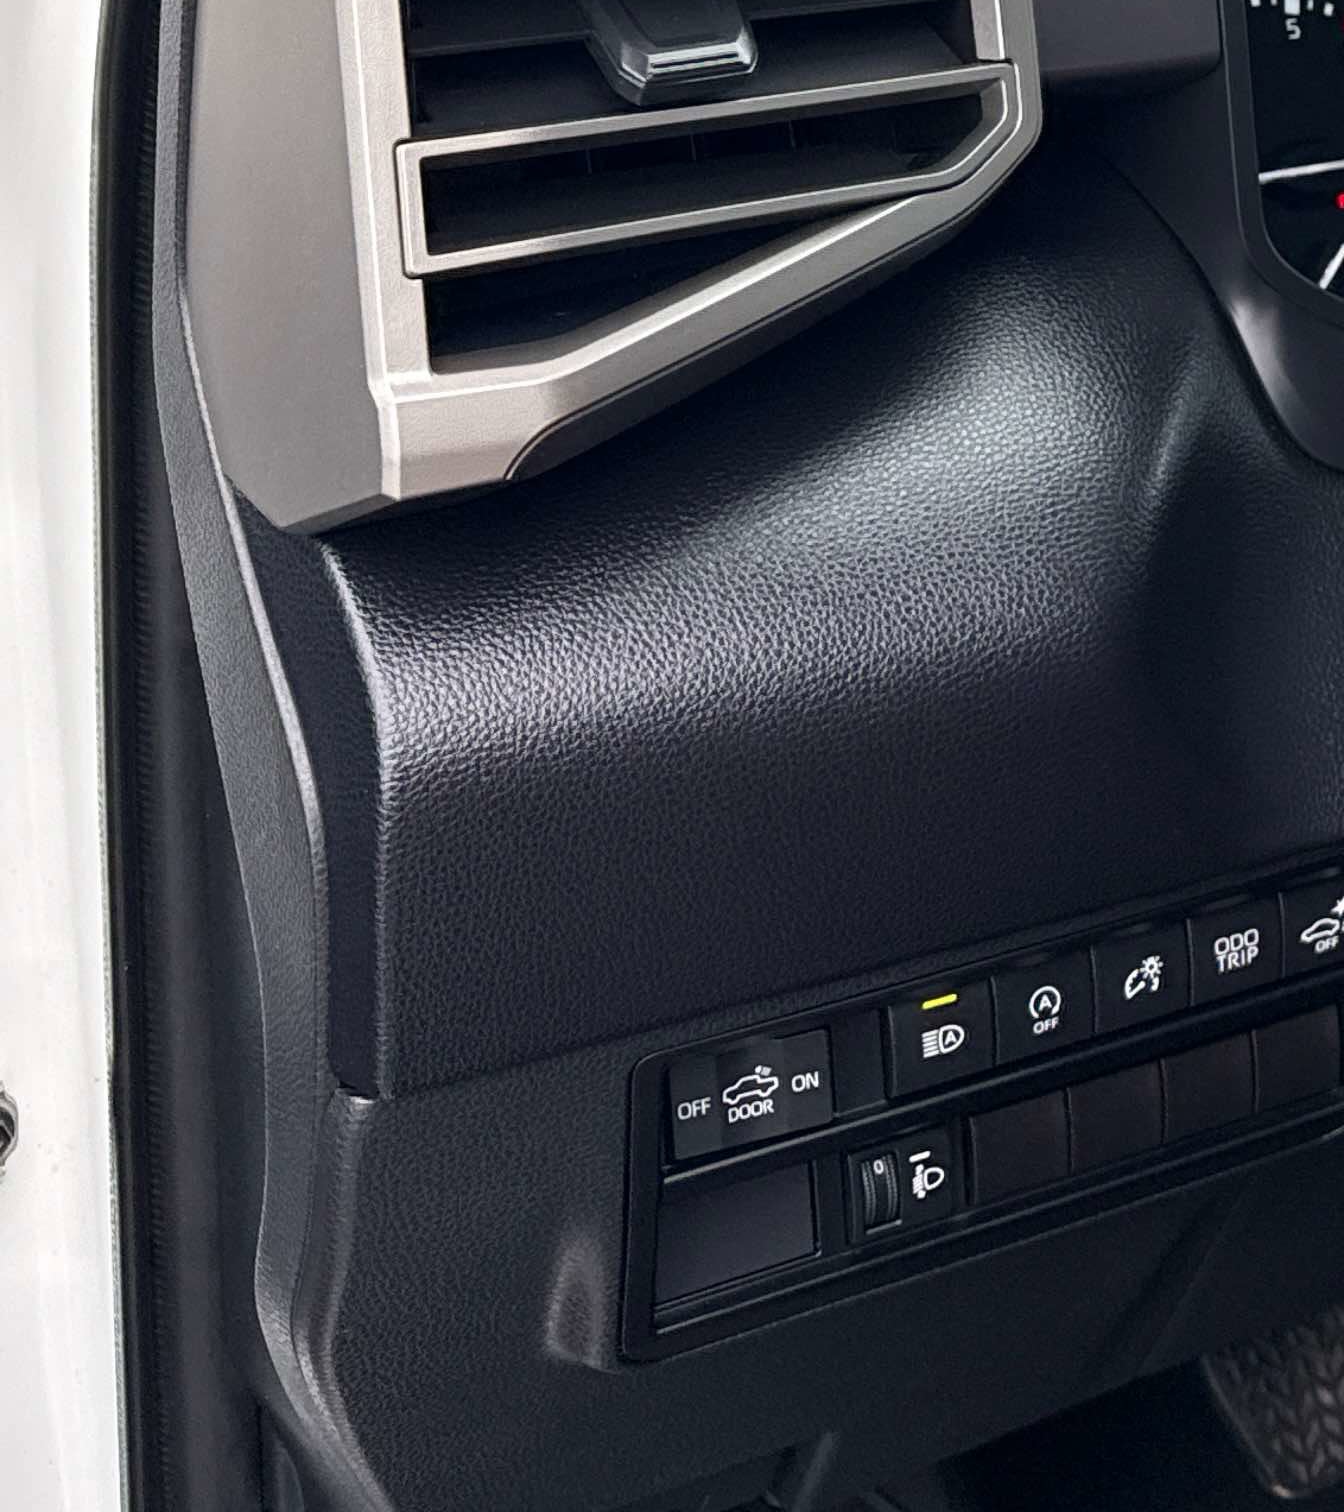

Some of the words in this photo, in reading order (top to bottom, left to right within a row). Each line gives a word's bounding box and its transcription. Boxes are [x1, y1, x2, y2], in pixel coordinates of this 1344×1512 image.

[1285, 18, 1301, 40] 5
[1214, 928, 1260, 956] ODO
[1314, 935, 1340, 955] OFF
[1216, 946, 1259, 973] TRIP
[1033, 1016, 1060, 1036] OFF
[677, 1096, 712, 1121] OFF
[728, 1098, 775, 1124] DOOR
[791, 1071, 820, 1093] ON
[873, 1159, 885, 1175] 0
